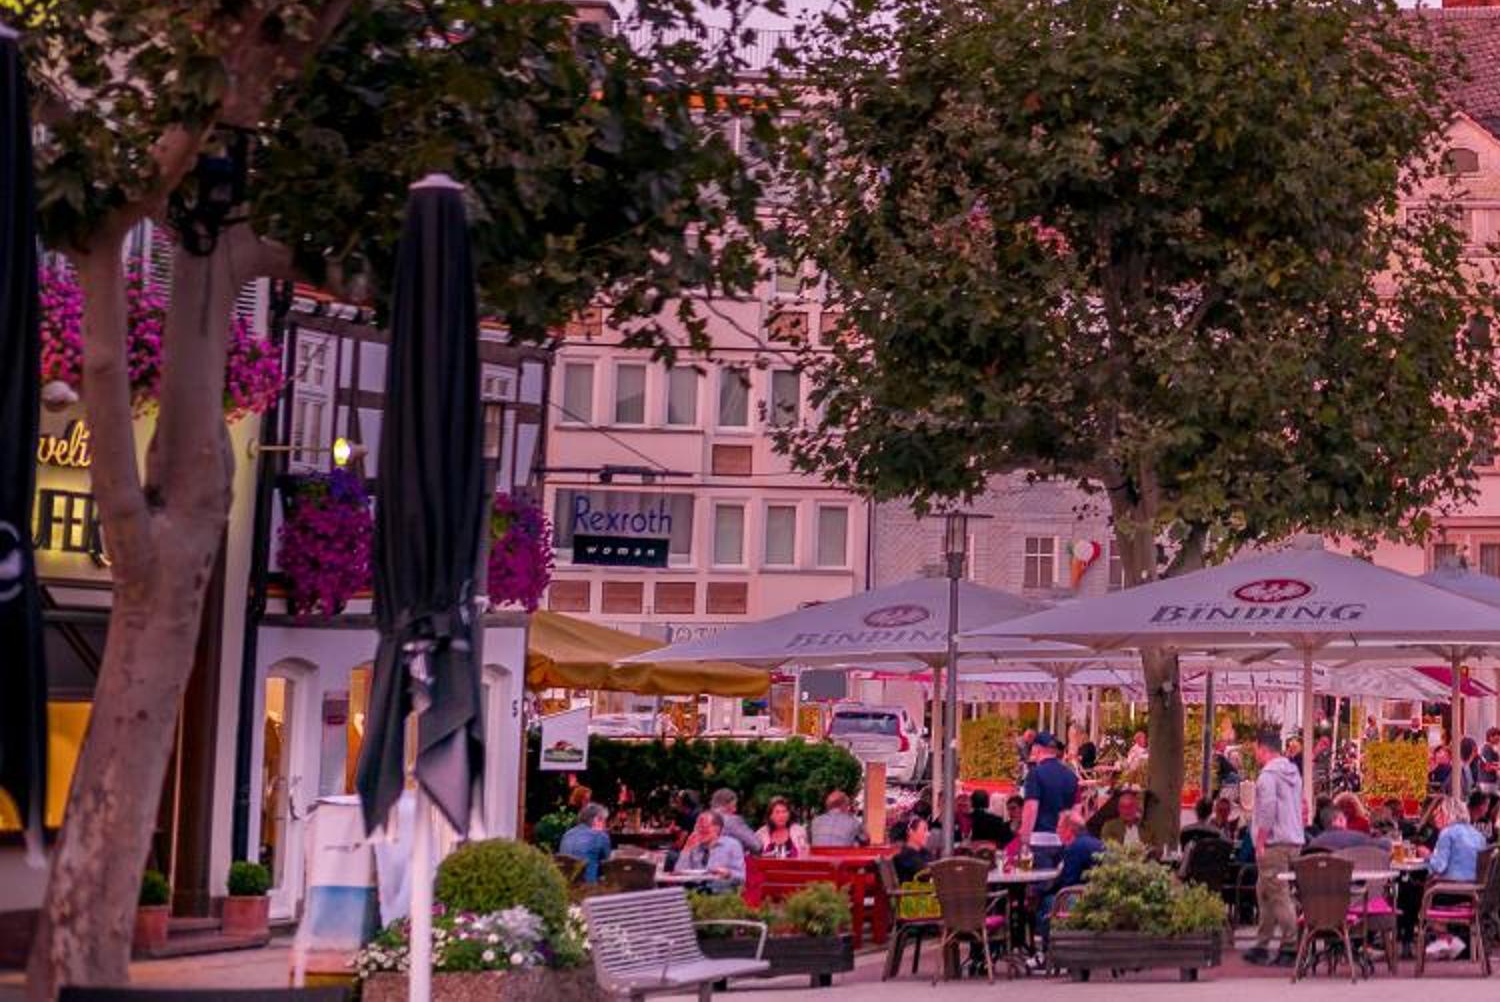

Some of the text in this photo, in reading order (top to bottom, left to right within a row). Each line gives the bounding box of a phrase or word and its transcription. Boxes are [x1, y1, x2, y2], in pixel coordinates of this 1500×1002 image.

[573, 495, 672, 535] Rexroth
[1150, 602, 1368, 623] BINDING
[785, 629, 948, 648] BINDIN
